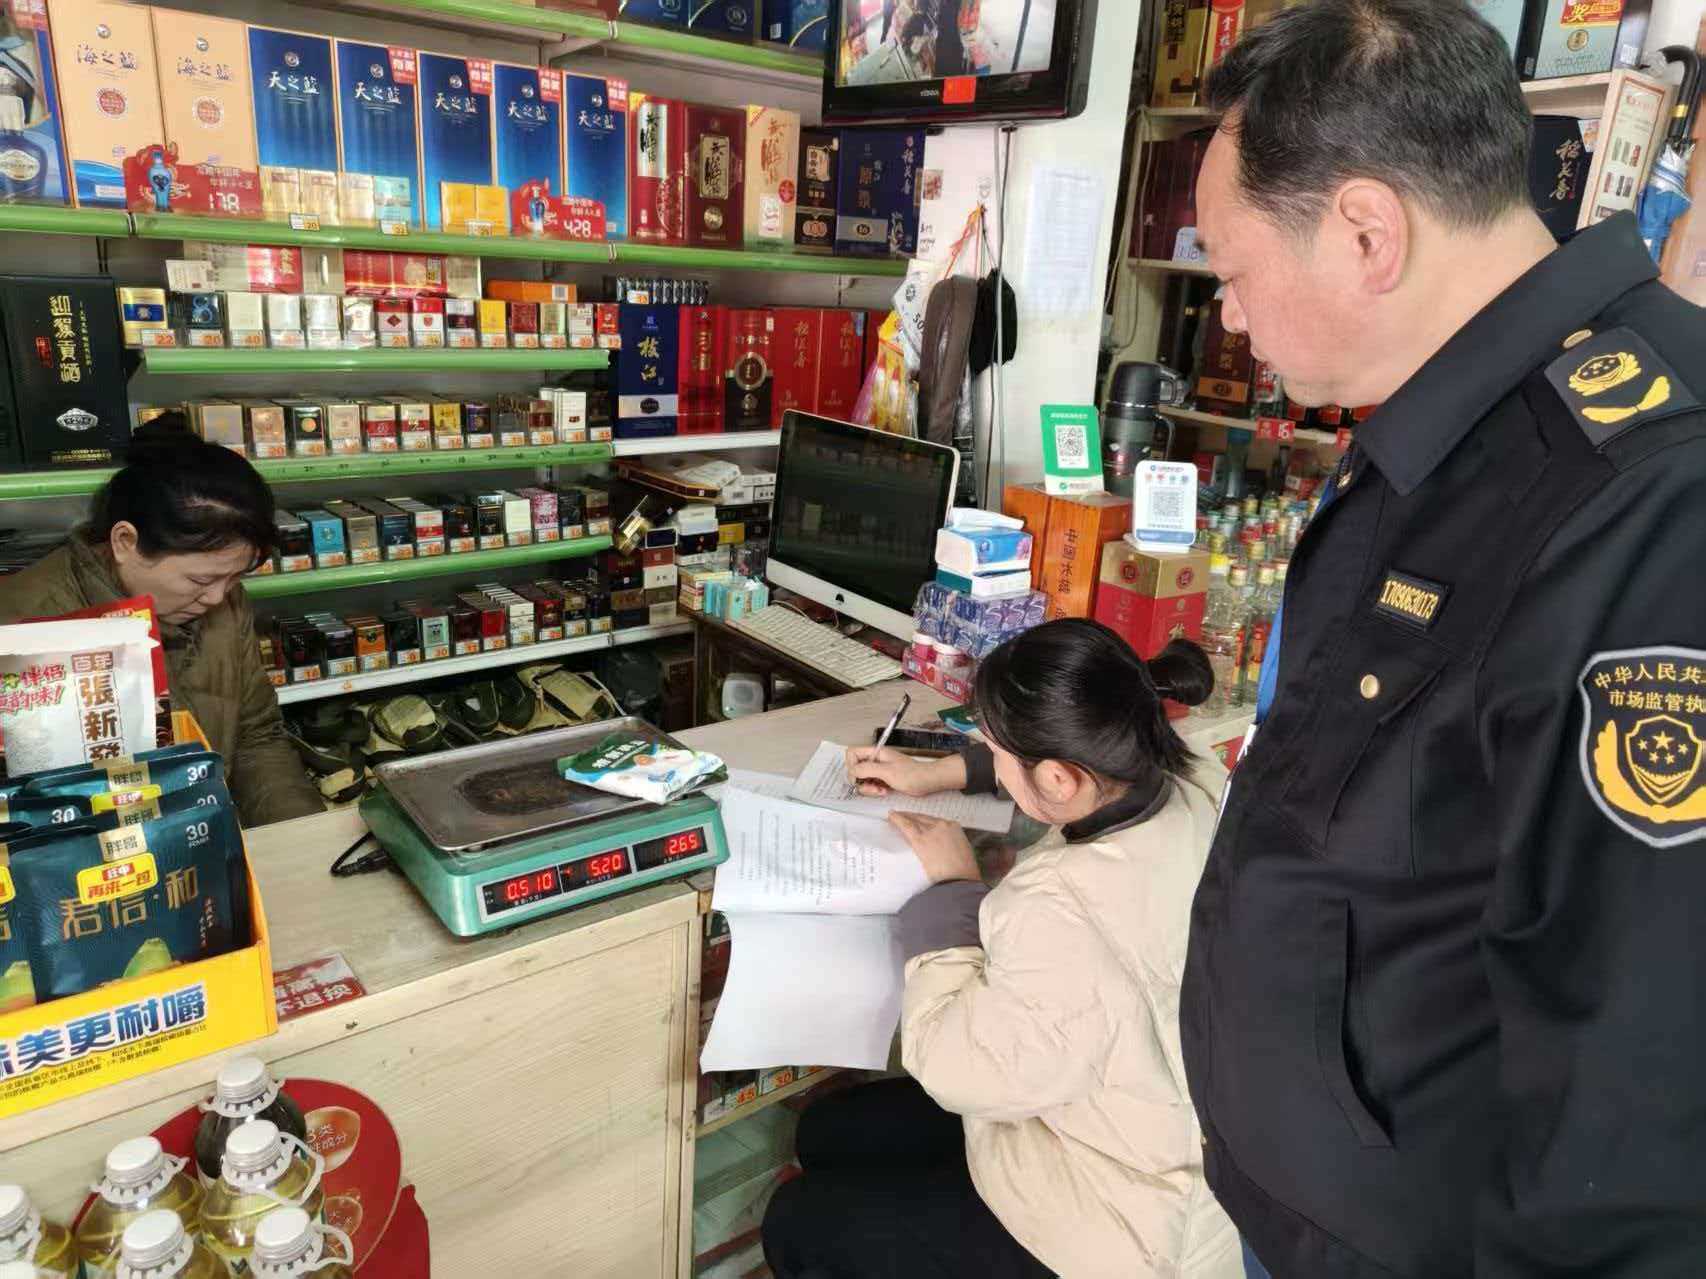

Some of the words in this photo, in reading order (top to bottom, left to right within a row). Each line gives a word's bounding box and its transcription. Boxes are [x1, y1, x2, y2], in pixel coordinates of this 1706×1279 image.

[209, 193, 240, 214] 178
[563, 220, 592, 239] 428
[1594, 662, 1706, 688] 中华人民共
[187, 764, 208, 781] 30
[51, 808, 75, 823] 30
[186, 822, 208, 841] 30
[88, 870, 150, 899] 再来一包
